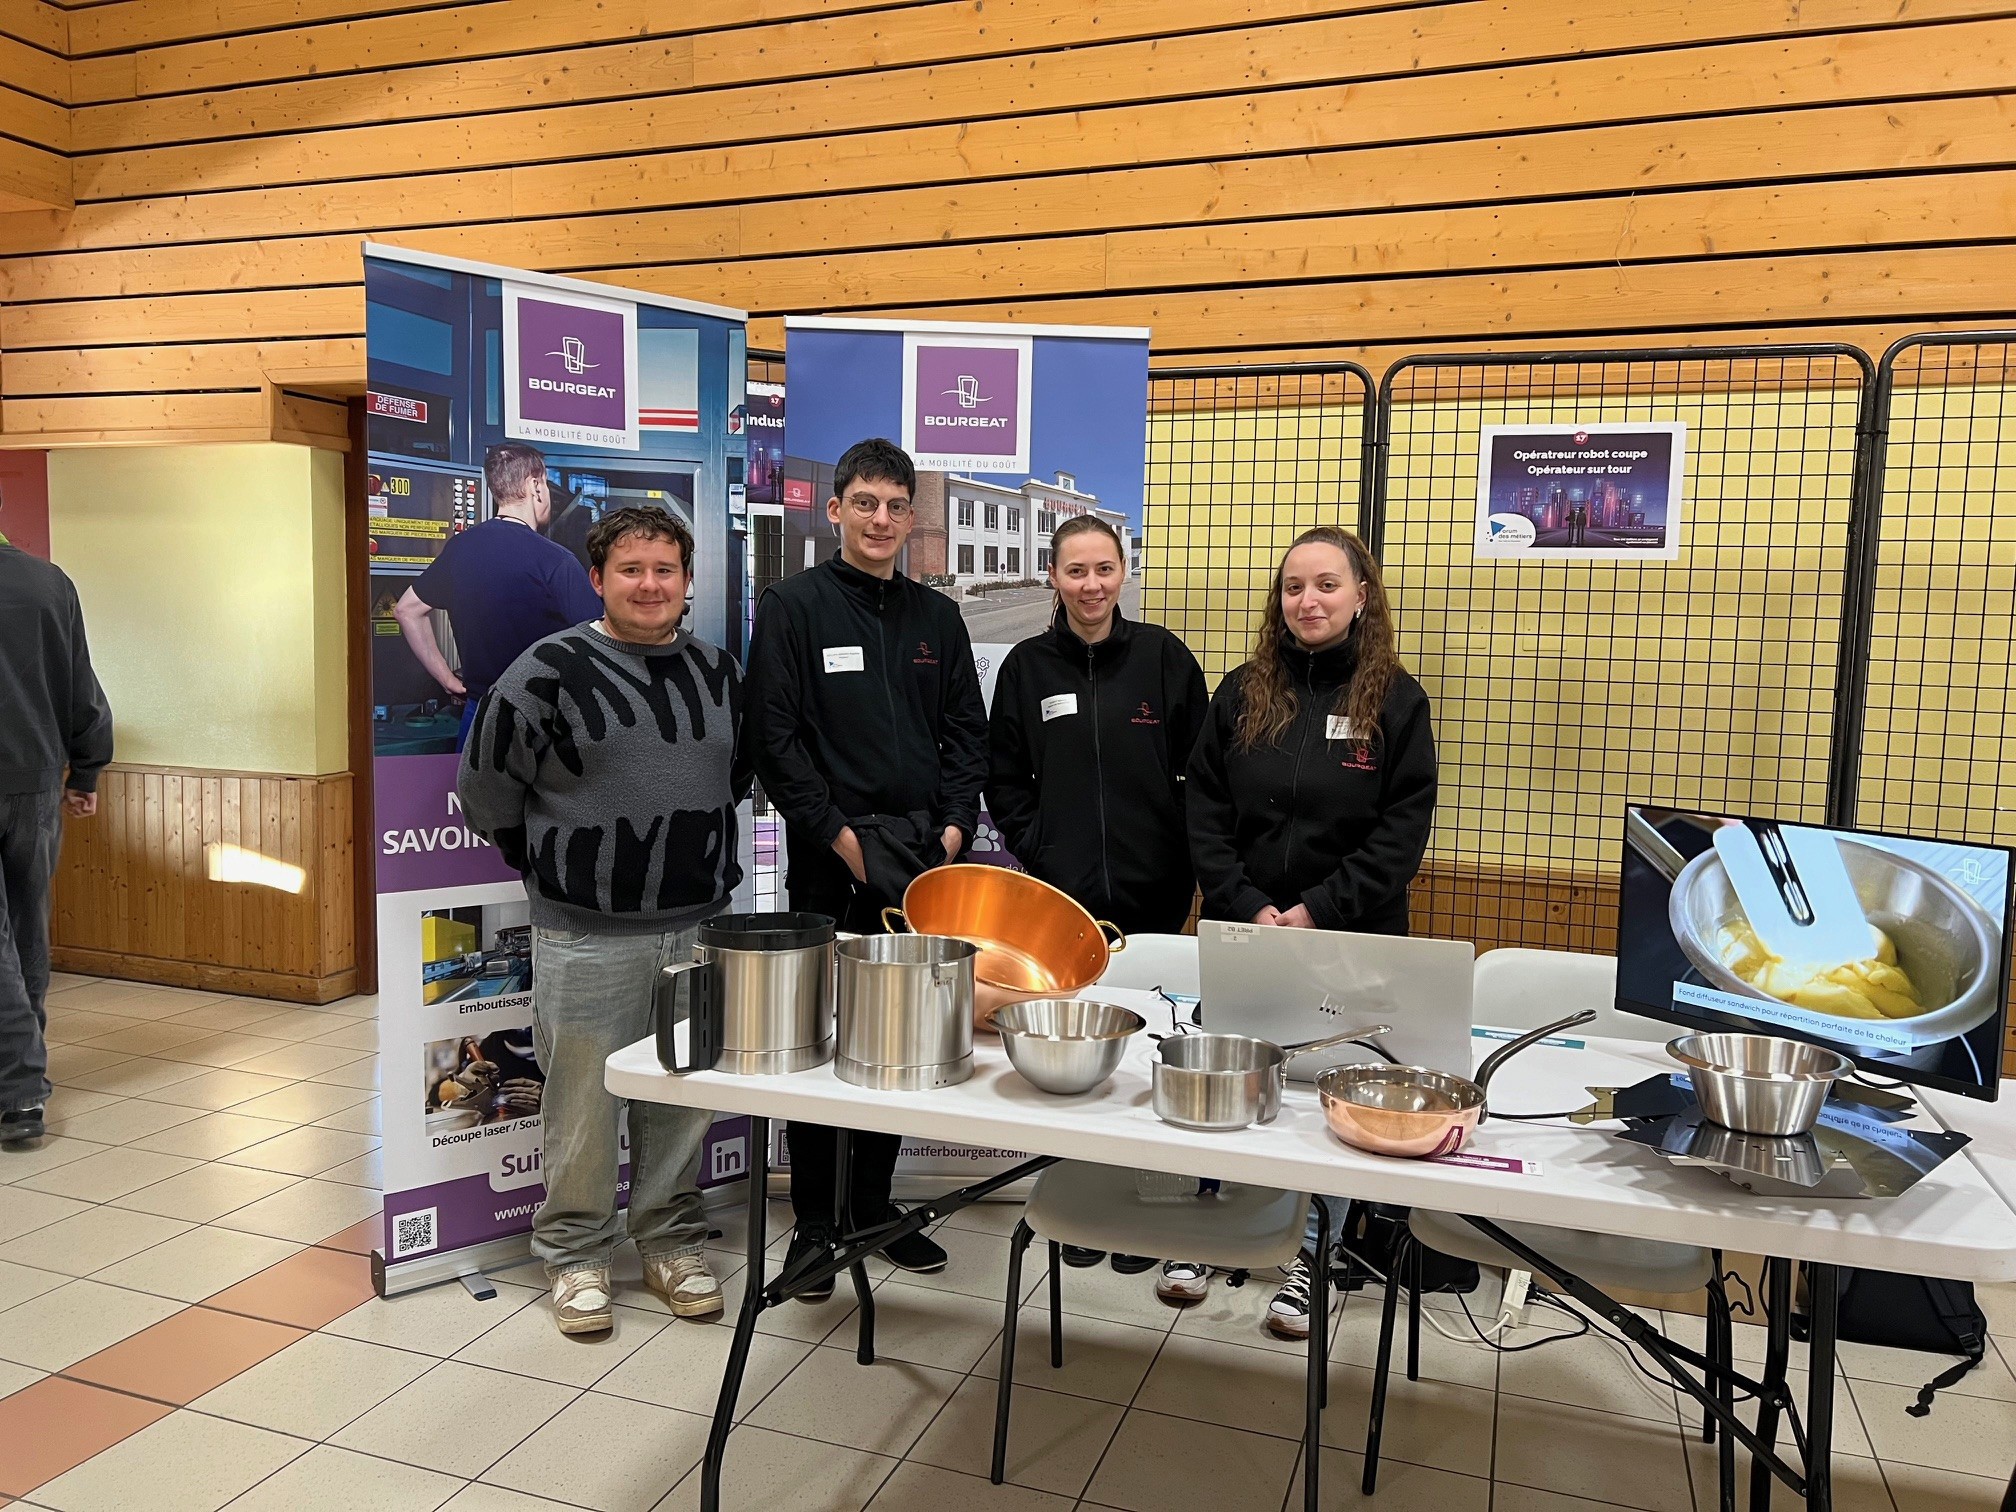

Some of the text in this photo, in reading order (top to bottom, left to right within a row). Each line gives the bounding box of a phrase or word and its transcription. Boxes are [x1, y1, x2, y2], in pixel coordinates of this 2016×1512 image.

[528, 378, 616, 398] BOURGEAT
[376, 403, 387, 411] DE
[390, 406, 418, 417] FUMER
[924, 416, 1008, 428] BOURGEAT
[519, 426, 626, 444] LA MOBILITÉ DU GOÛT
[1514, 450, 1648, 461] Opératreur robot coupe
[928, 459, 972, 468] MOBILITÉ
[992, 461, 1016, 469] GOÛT
[1527, 465, 1632, 476] Opérateur sur tour
[392, 479, 408, 494] 300
[1679, 989, 1695, 998] Fond
[1696, 993, 1726, 1004] diffuseur
[1728, 1000, 1760, 1012] sandwich
[1762, 1008, 1778, 1016] pour
[1780, 1013, 1819, 1026] répartition
[1822, 1022, 1852, 1034] parfaite
[1866, 1030, 1874, 1039] la
[1876, 1033, 1906, 1046] chaleur
[432, 1128, 482, 1148] Découpe
[484, 1123, 510, 1137] laser
[513, 1121, 518, 1132] /
[716, 1147, 741, 1174] in
